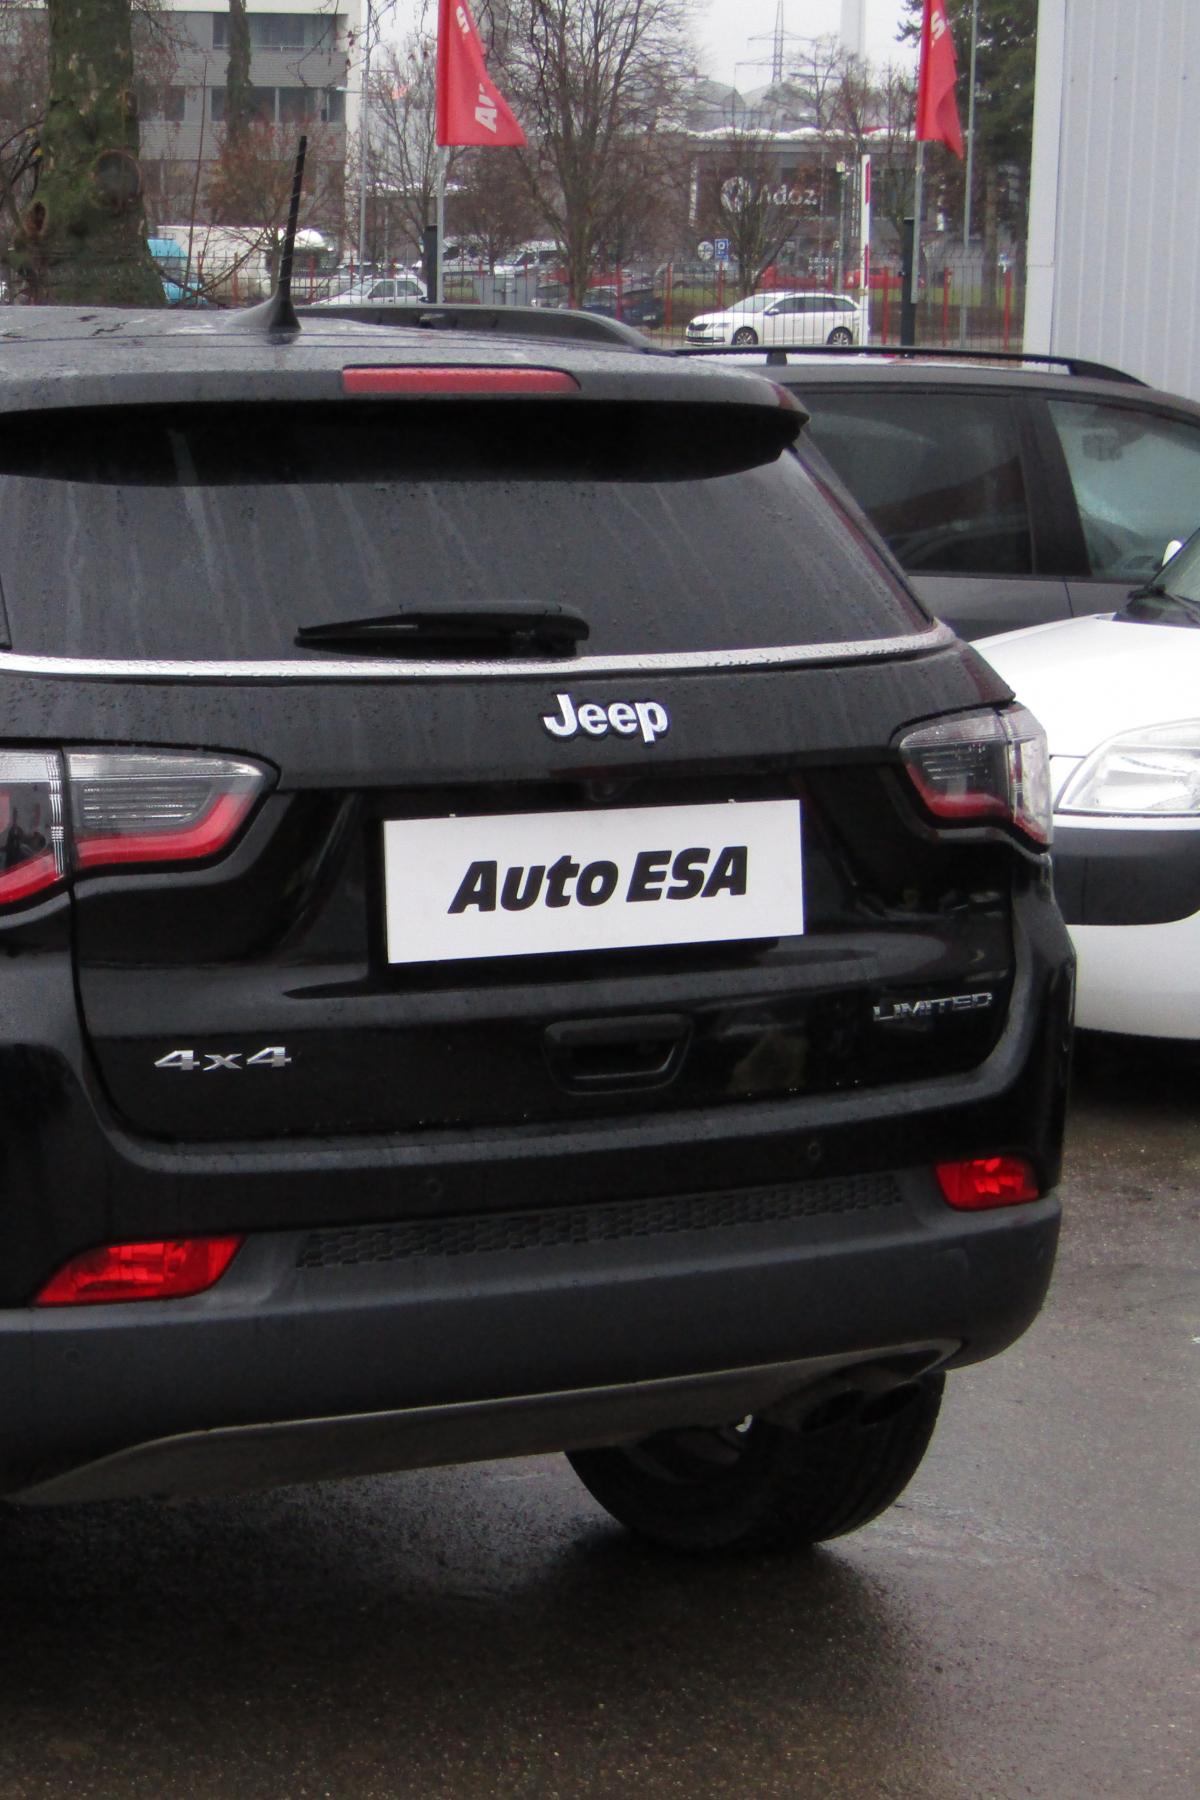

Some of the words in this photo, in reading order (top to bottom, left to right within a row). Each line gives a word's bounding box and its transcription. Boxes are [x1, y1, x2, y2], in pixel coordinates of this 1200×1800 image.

[543, 693, 668, 743] Jeep
[447, 855, 619, 914] Auto
[626, 846, 749, 902] ESA
[873, 992, 992, 1021] LIMITED
[154, 1046, 292, 1071] 4x4
